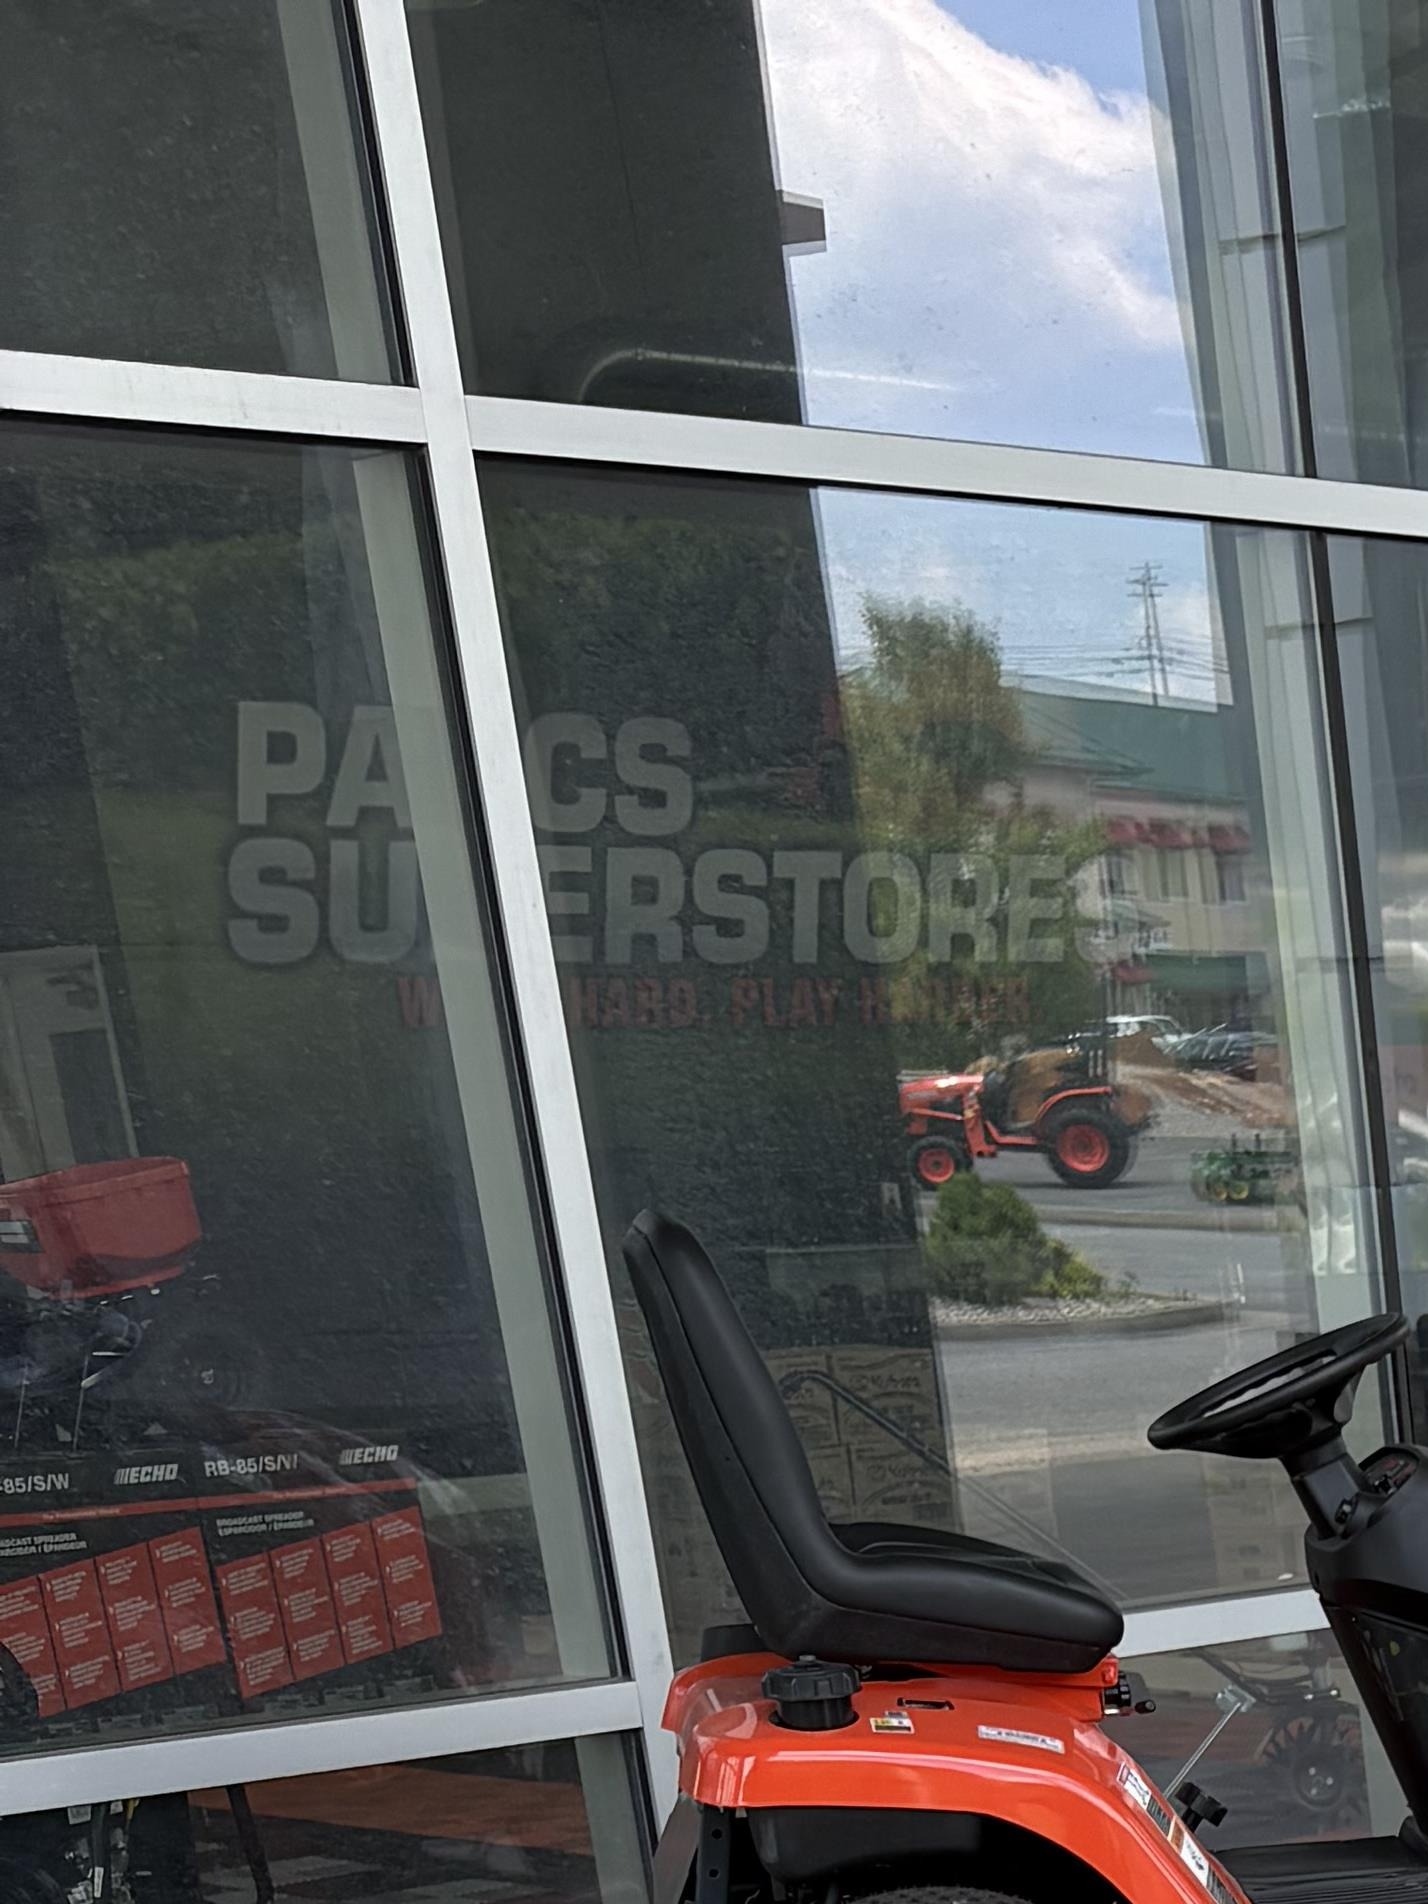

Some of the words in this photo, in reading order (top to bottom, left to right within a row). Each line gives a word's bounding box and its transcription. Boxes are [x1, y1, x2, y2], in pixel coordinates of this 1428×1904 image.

[237, 701, 692, 836] PACS
[228, 836, 1133, 966] SUERSTORES
[117, 1464, 179, 1484] ECHO
[340, 1445, 398, 1465] ECHO
